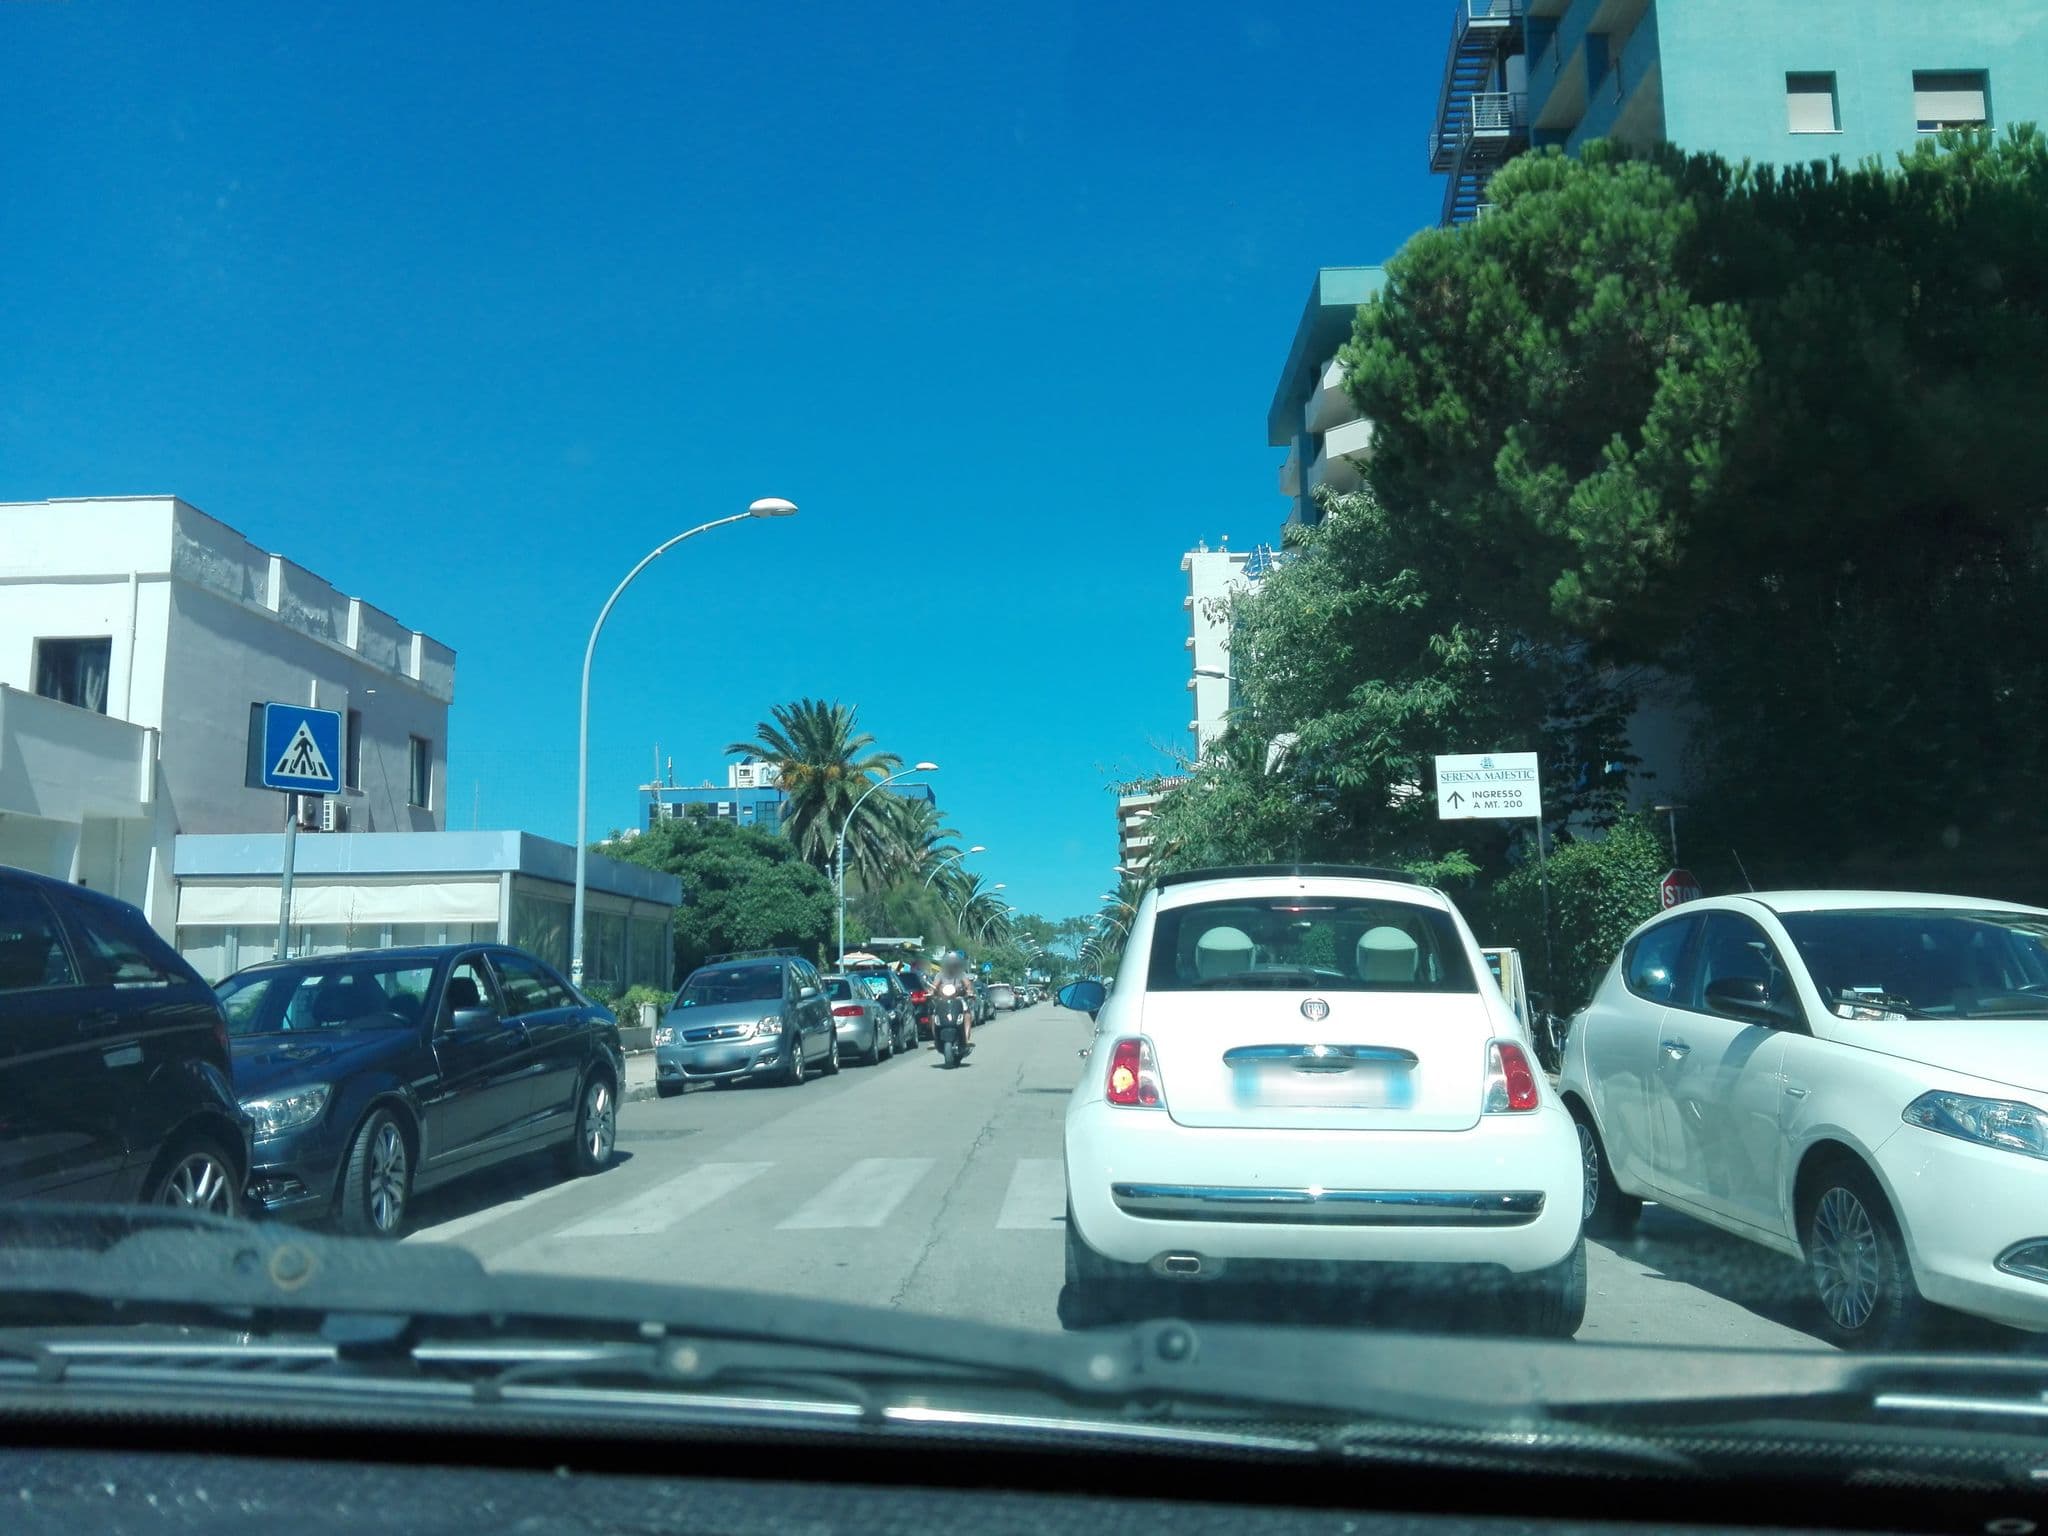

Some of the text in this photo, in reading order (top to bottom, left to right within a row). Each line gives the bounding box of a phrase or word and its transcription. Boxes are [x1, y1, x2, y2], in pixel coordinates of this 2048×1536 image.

[1440, 770, 1535, 782] SERENA MAJESTIC
[1472, 789, 1522, 799] INGRESSO
[1473, 801, 1480, 809] A
[1504, 800, 1523, 808] 200
